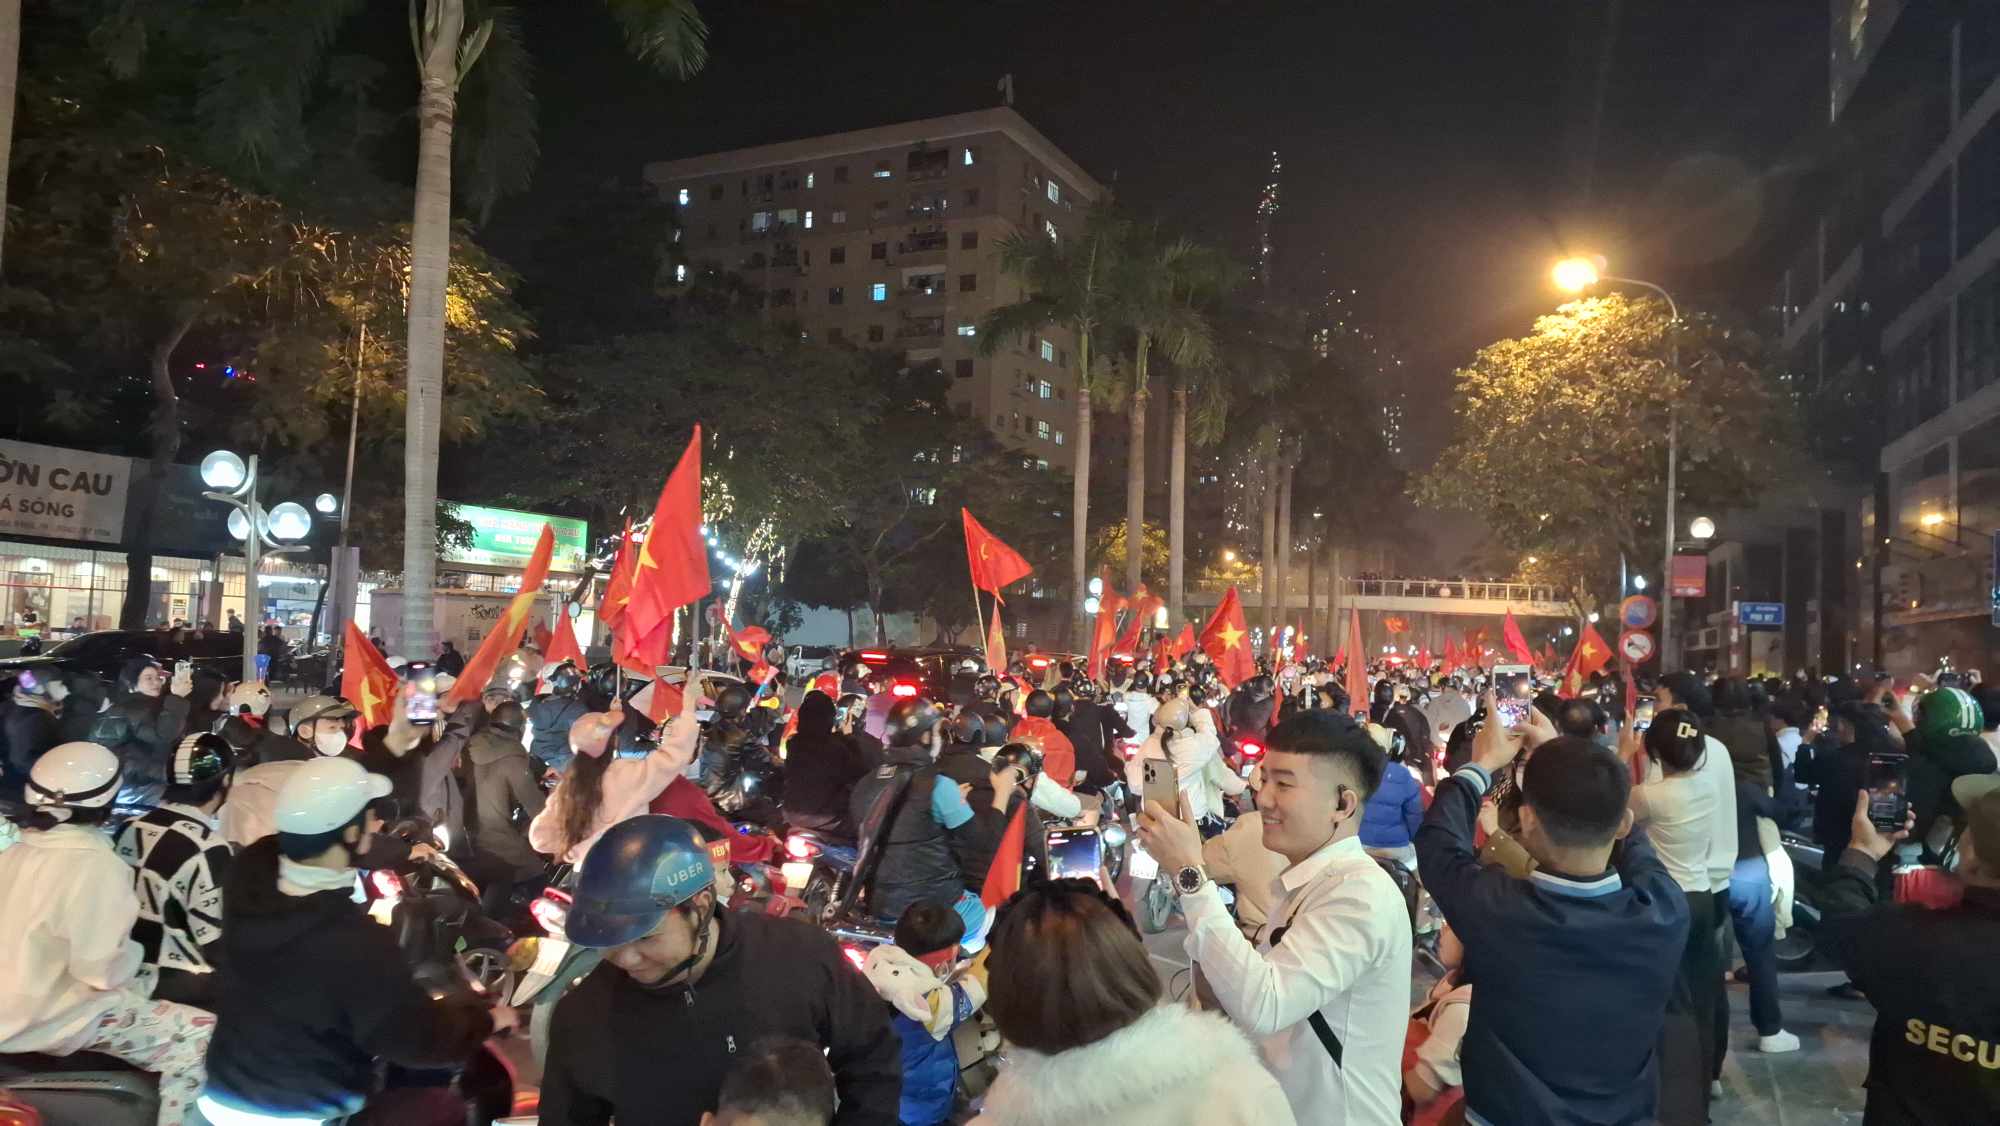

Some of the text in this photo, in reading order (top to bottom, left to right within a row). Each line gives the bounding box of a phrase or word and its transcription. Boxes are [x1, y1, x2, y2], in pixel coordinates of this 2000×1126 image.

[49, 468, 112, 496] CAU
[18, 497, 74, 518] SÔNG
[667, 862, 704, 886] UBER
[1905, 1018, 2000, 1069] SECU
